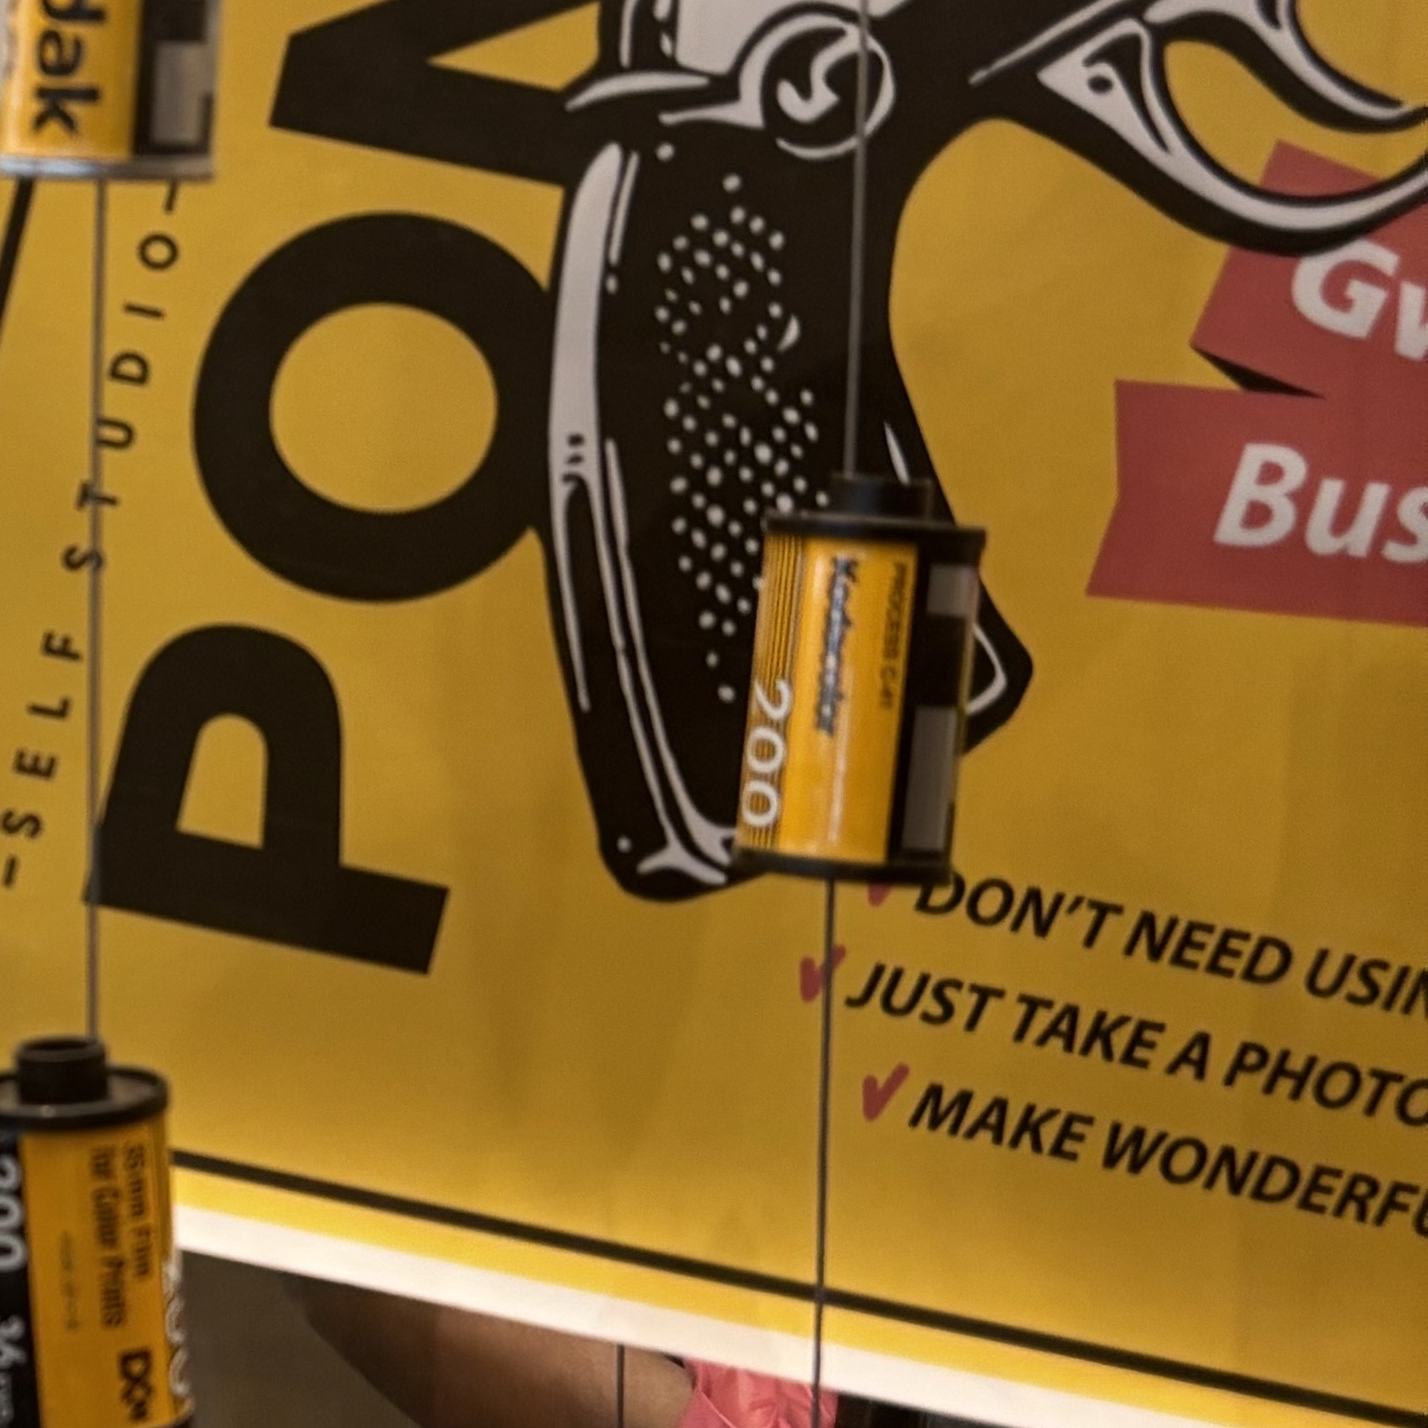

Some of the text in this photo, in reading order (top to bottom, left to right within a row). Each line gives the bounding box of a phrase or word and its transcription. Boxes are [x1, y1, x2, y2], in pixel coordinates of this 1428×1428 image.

[742, 676, 794, 830] 200
[1123, 909, 1293, 986] NEED
[845, 962, 1428, 1128] JUST TAKE A PHOTO
[907, 1082, 1097, 1163] MAKE
